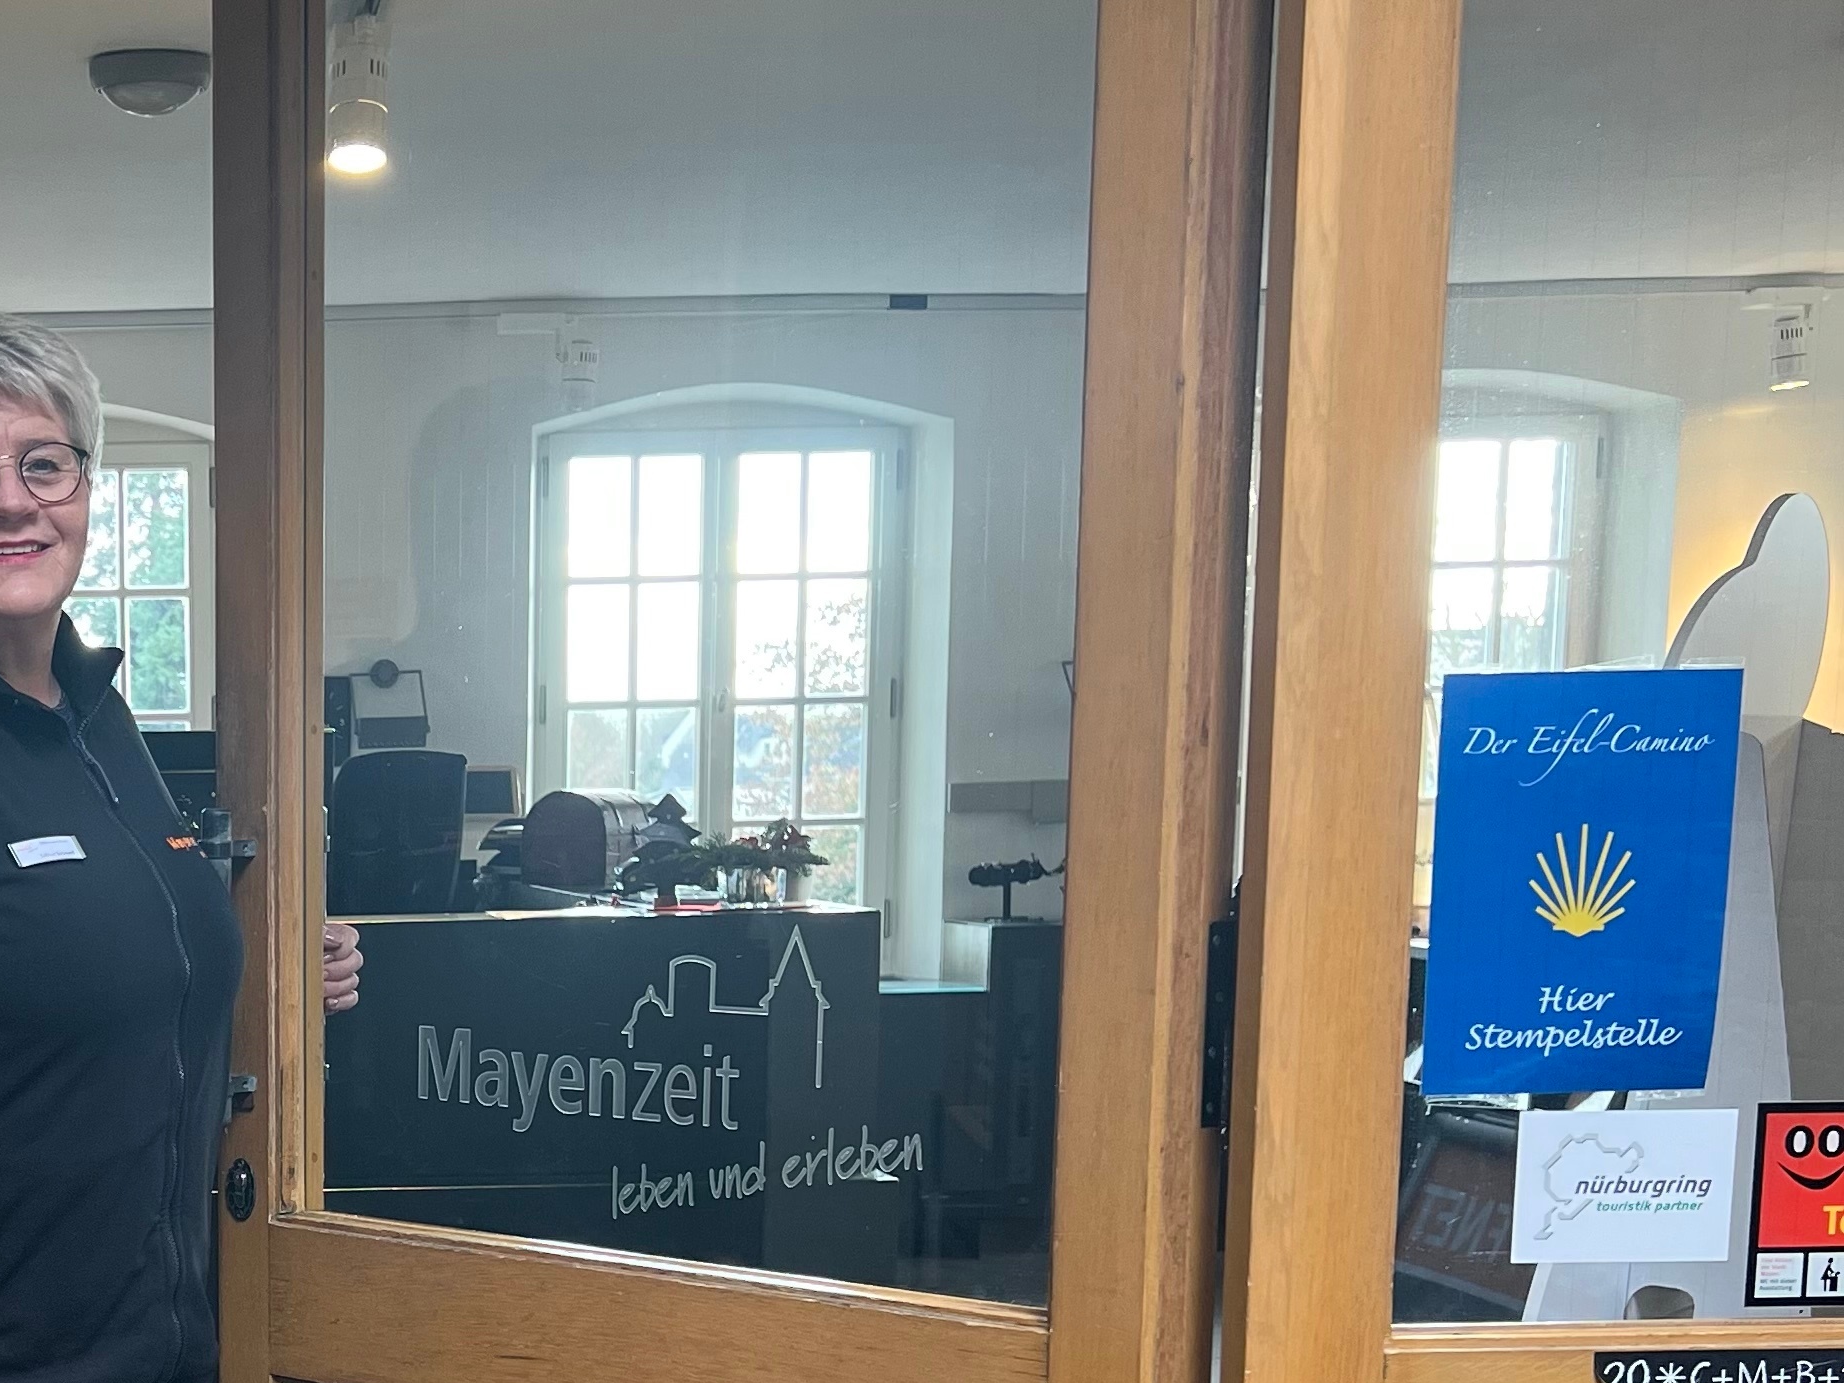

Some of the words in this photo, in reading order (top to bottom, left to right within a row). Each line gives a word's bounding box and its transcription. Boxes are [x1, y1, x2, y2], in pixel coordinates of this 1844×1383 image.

[1463, 727, 1517, 755] Der
[1518, 708, 1715, 787] Eifel-Camino
[1538, 984, 1615, 1014] Hier
[1464, 1018, 1683, 1057] Stempelstelle
[416, 1024, 740, 1132] Mayenzeit
[611, 1164, 694, 1219] leben
[708, 1140, 766, 1199] und
[781, 1124, 924, 1189] erleben
[1575, 1175, 1713, 1198] nürburgring
[1596, 1200, 1652, 1213] touristik
[1654, 1200, 1704, 1214] partner
